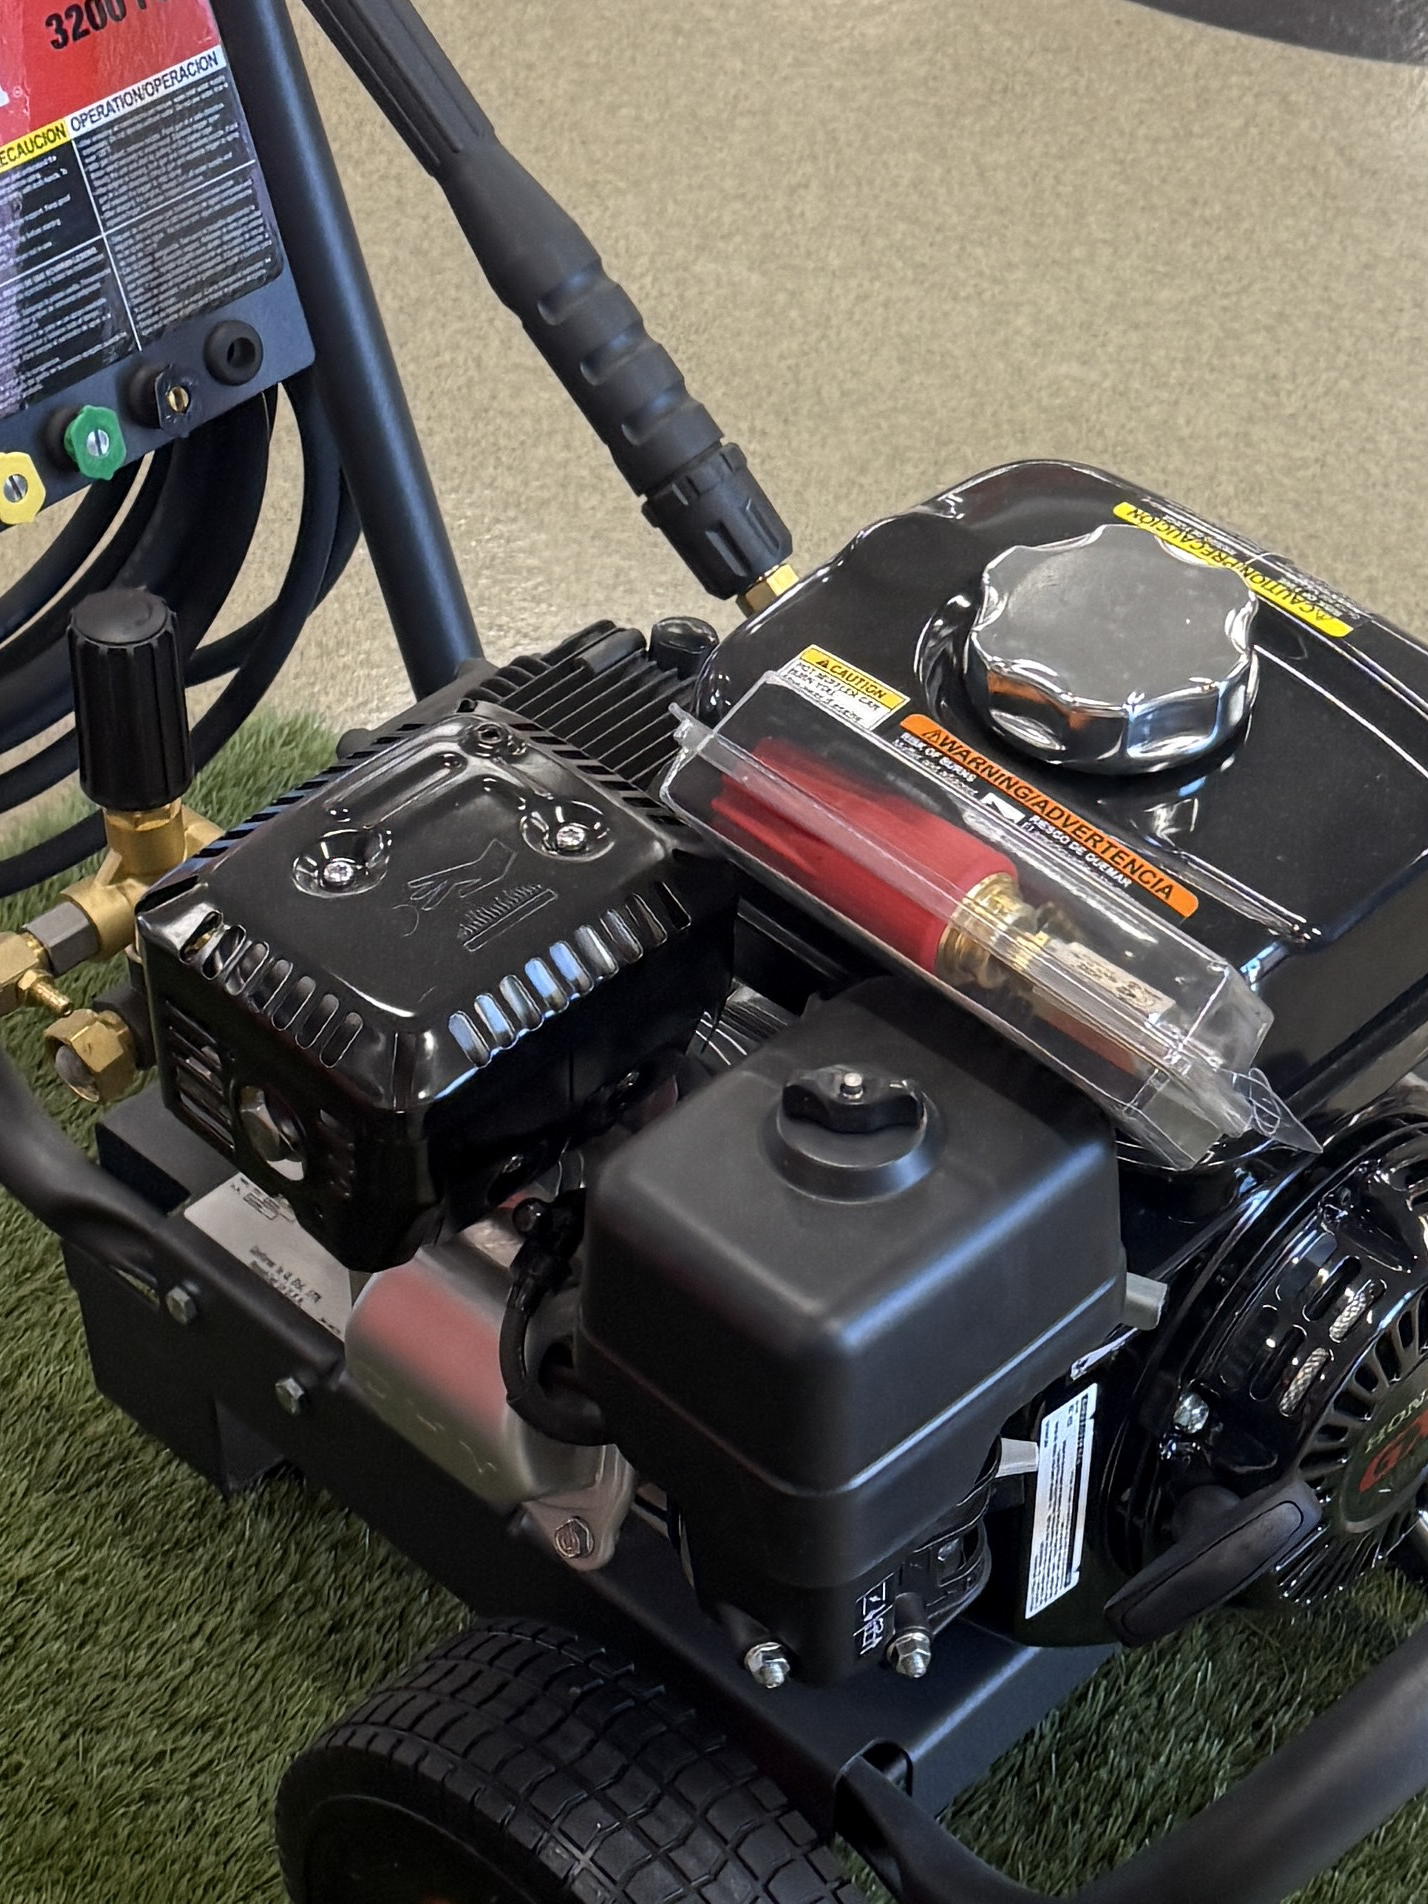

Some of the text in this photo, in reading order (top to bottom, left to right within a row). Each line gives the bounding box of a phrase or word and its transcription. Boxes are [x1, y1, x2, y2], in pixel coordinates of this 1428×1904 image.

[71, 51, 219, 132] OPERATION/OPERACION
[829, 664, 888, 699] CAUTION
[940, 734, 1175, 901] WARNING/ADVERTENCIA
[1068, 842, 1088, 856] DE
